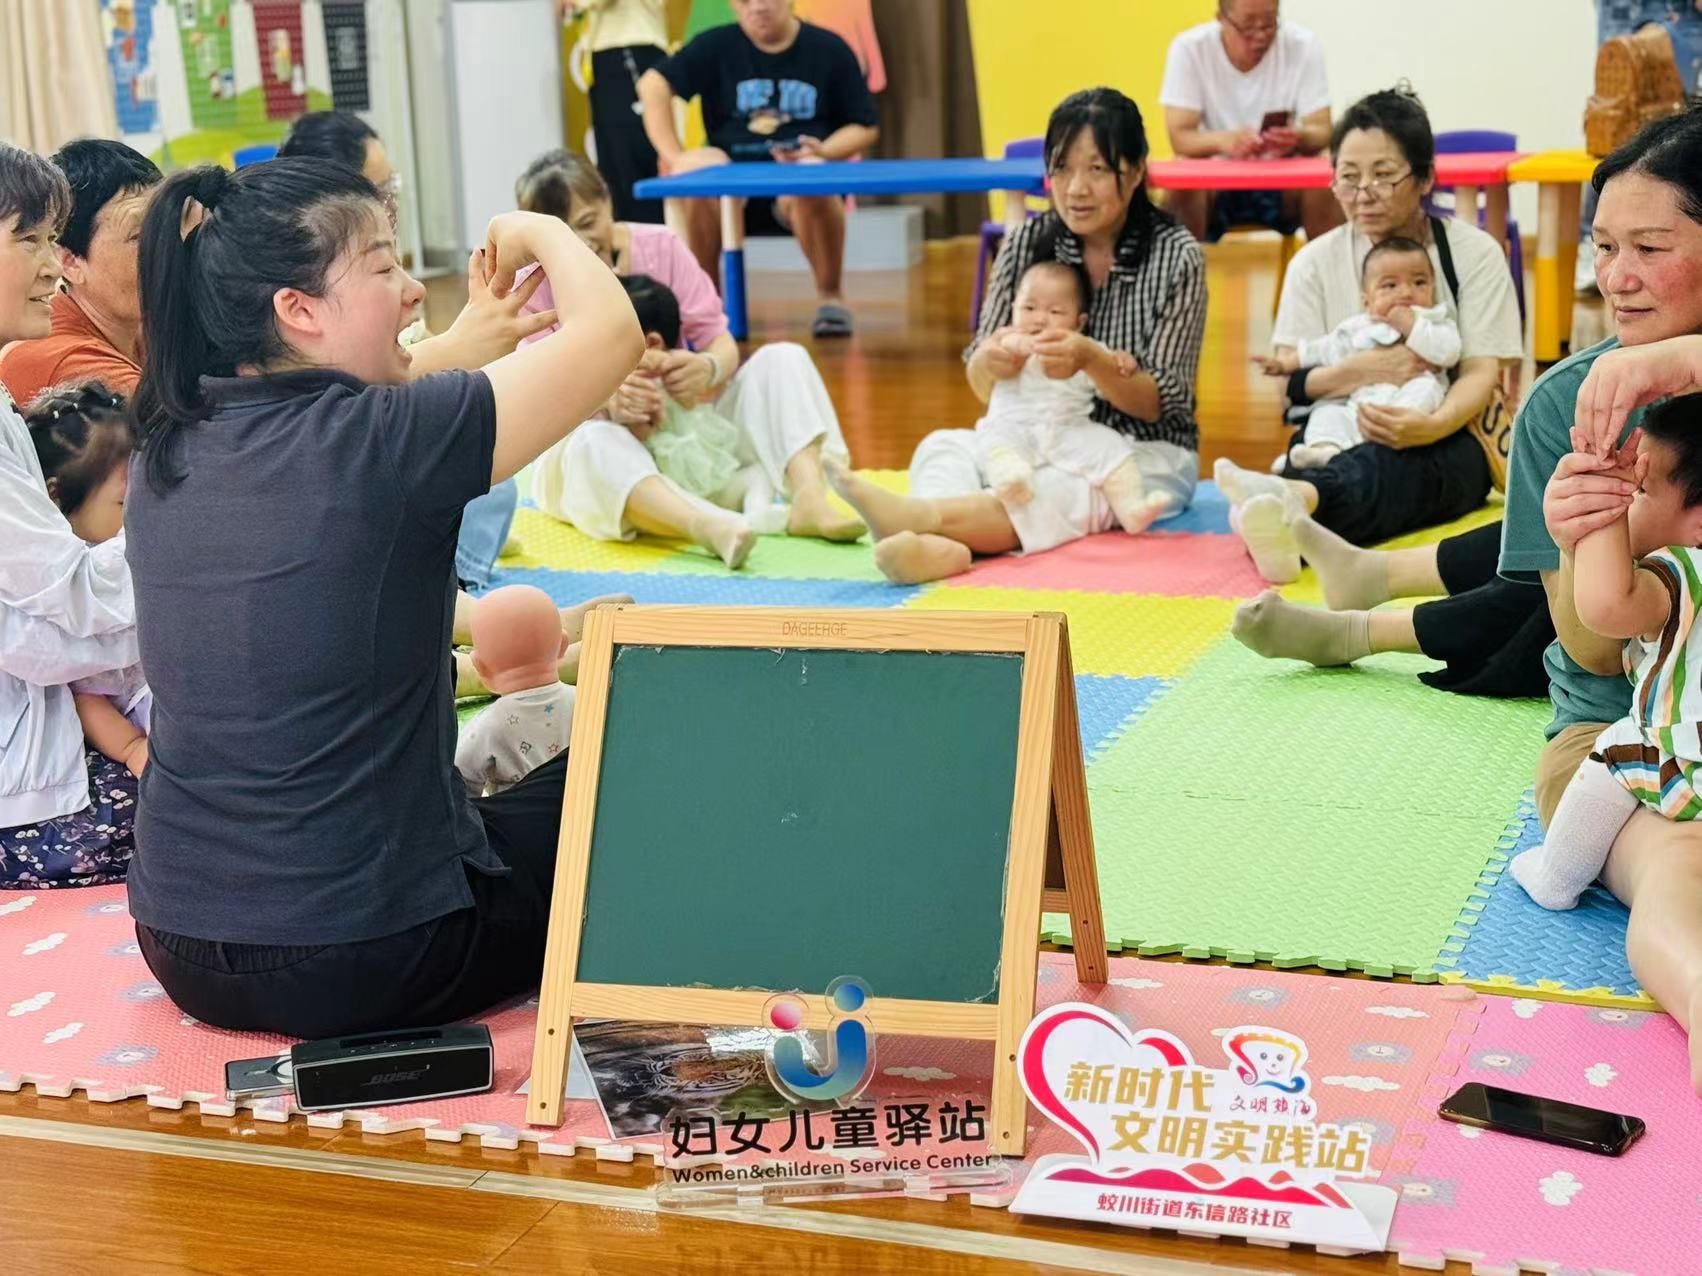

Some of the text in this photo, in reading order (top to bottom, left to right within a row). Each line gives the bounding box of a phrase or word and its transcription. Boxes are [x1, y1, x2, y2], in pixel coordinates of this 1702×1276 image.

[362, 1070, 424, 1087] BOSE
[1063, 1061, 1215, 1113] 新时代
[669, 1100, 986, 1158] 妇女儿童驿站
[1106, 1111, 1368, 1173] 文明实践站
[672, 1152, 993, 1184] Women&children Service Center
[1096, 1192, 1293, 1229] 蛟川街道东信路社区
